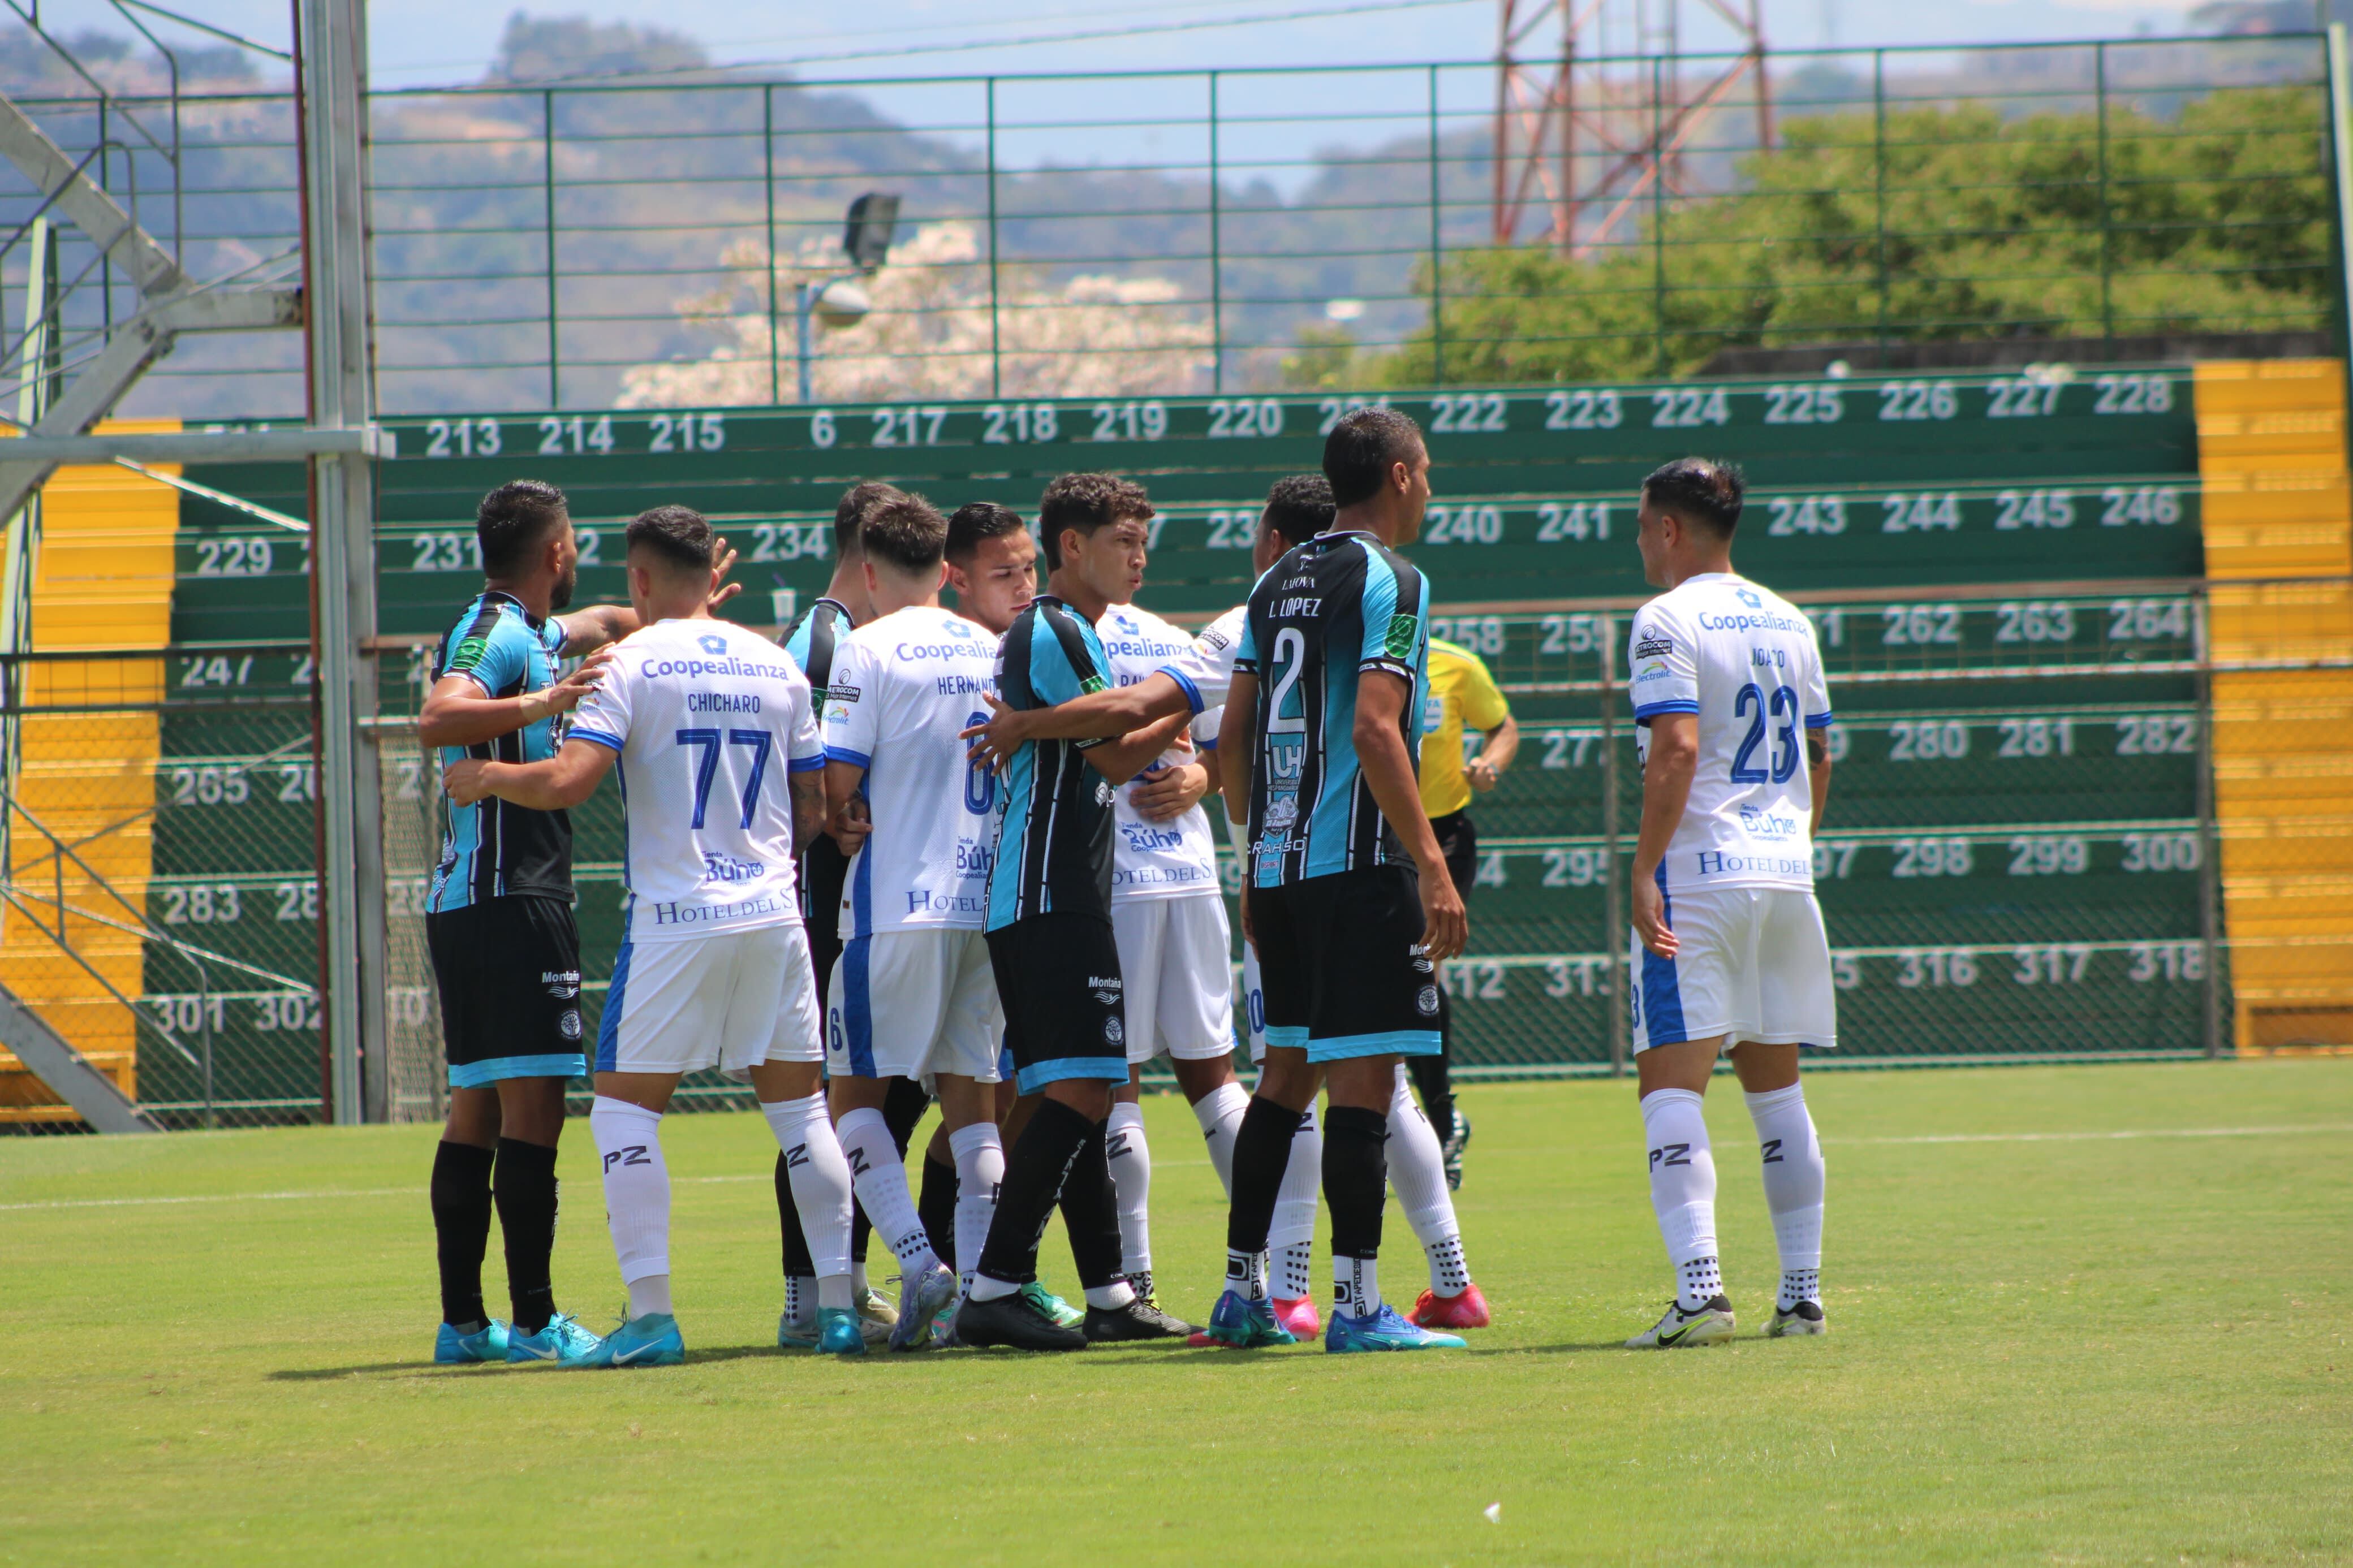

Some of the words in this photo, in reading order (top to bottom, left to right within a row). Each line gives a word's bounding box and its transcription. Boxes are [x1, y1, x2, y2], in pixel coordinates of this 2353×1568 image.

[426, 418, 502, 458] 213
[538, 414, 614, 455] 214
[649, 413, 725, 451] 215
[871, 406, 947, 447] 217
[982, 403, 1058, 443] 218
[1092, 400, 1167, 441] 219
[1208, 398, 1284, 438] 220
[1431, 393, 1508, 433] 222
[1545, 390, 1623, 430] 223
[1652, 386, 1730, 427] 224
[1765, 384, 1844, 424] 225
[1879, 381, 1958, 420] 226
[1986, 377, 2065, 417] 227
[2095, 374, 2173, 414] 228
[196, 537, 272, 574] 229
[413, 532, 482, 571] 231
[752, 522, 828, 561] 234
[1206, 510, 1257, 550] 23
[1426, 504, 1502, 544] 240
[1537, 501, 1610, 541] 241
[1768, 495, 1847, 536] 243
[1882, 492, 1961, 533] 244
[1996, 489, 2075, 529] 245
[2101, 486, 2181, 526] 246
[1279, 597, 1322, 617] LOPEZ
[1698, 611, 1809, 638] Coopealianza
[182, 656, 253, 686] 247
[1882, 603, 1961, 645] 262
[1996, 601, 2075, 642] 263
[2109, 598, 2187, 640] 264
[896, 641, 997, 662] Coopealia
[640, 656, 789, 681] Coopealianza
[1267, 627, 1305, 734] 2
[938, 676, 997, 697] HERNAND
[688, 693, 760, 714] CHICHARO
[1731, 683, 1799, 784] 23
[171, 766, 249, 805] 265
[1541, 729, 1606, 769] 27
[1890, 720, 1969, 762] 280
[1998, 717, 2075, 758] 281
[2116, 715, 2196, 756] 282
[676, 728, 772, 830] 77
[956, 844, 992, 871] Búh
[1697, 850, 1777, 876] HOTEL
[163, 883, 241, 925] 283
[275, 881, 318, 921] 28
[1813, 840, 1860, 879] 97
[1892, 837, 1975, 877] 298
[2008, 835, 2089, 875] 299
[2121, 833, 2203, 872] 300
[956, 870, 988, 880] Coopealia
[1111, 869, 1162, 885] OTEL
[1164, 866, 1200, 882] DEL
[654, 901, 738, 925] HOTEL
[742, 897, 781, 916] DEL
[906, 890, 984, 914] HOTEL
[152, 998, 225, 1034] 301
[1897, 951, 1977, 990] 316
[2013, 945, 2094, 985] 317
[2128, 942, 2206, 982] 318
[1088, 976, 1122, 988] Montaña
[830, 1007, 843, 1052] 6
[604, 1144, 652, 1175] PZ
[1649, 1142, 1691, 1173] PZ
